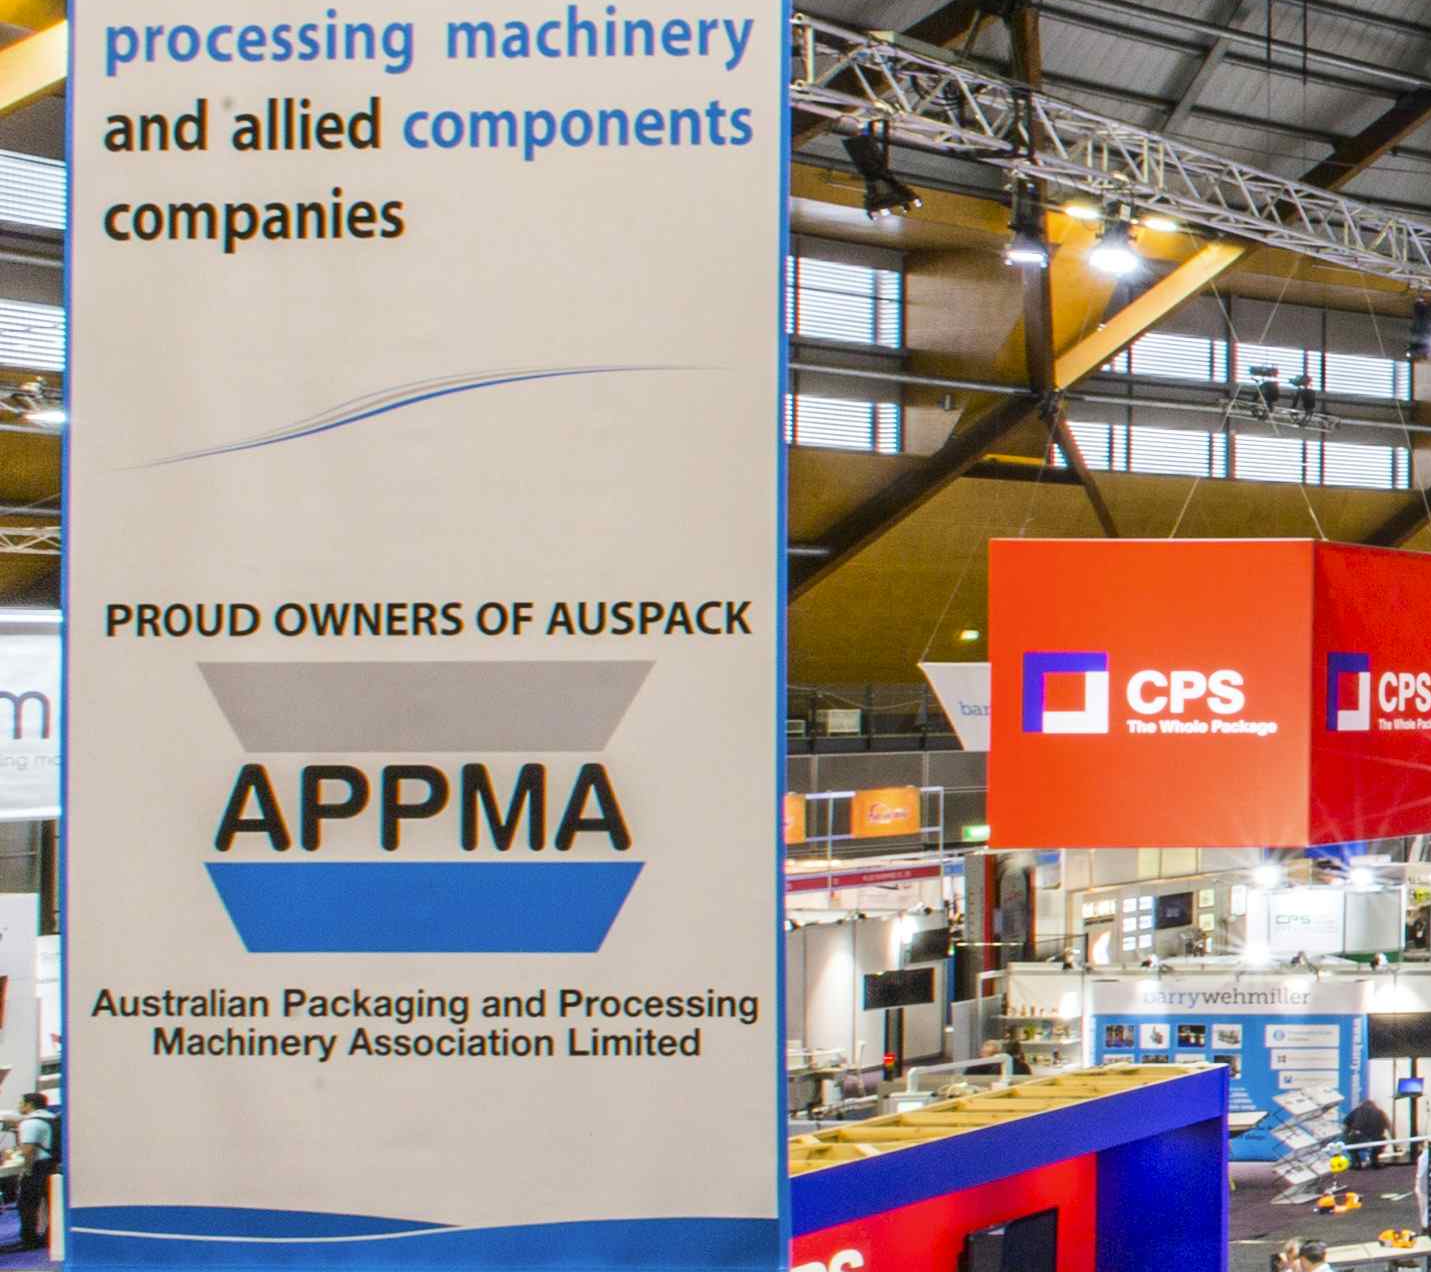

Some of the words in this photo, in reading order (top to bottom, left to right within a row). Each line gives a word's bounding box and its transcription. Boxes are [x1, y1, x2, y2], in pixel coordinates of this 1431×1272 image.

[105, 9, 414, 76] processing
[446, 6, 755, 70] machinery
[104, 99, 208, 152] and
[231, 97, 381, 150] allied
[403, 101, 754, 161] components
[104, 188, 405, 253] companies
[105, 602, 260, 638] PROUD
[273, 601, 463, 637] OWNERS
[476, 601, 534, 636] OF
[546, 600, 753, 636] AUSPACK
[1126, 670, 1245, 714] CPS
[1127, 719, 1155, 734] The
[1158, 719, 1209, 734] Whole
[1211, 719, 1278, 736] Package
[213, 762, 633, 852] APPMA
[92, 988, 271, 1019] Australian
[282, 988, 470, 1026] Packaging
[481, 988, 547, 1019] and
[559, 988, 759, 1025] Processing
[153, 1027, 336, 1063] Machinery
[349, 1027, 556, 1057] Association
[567, 1027, 702, 1057] Limited
